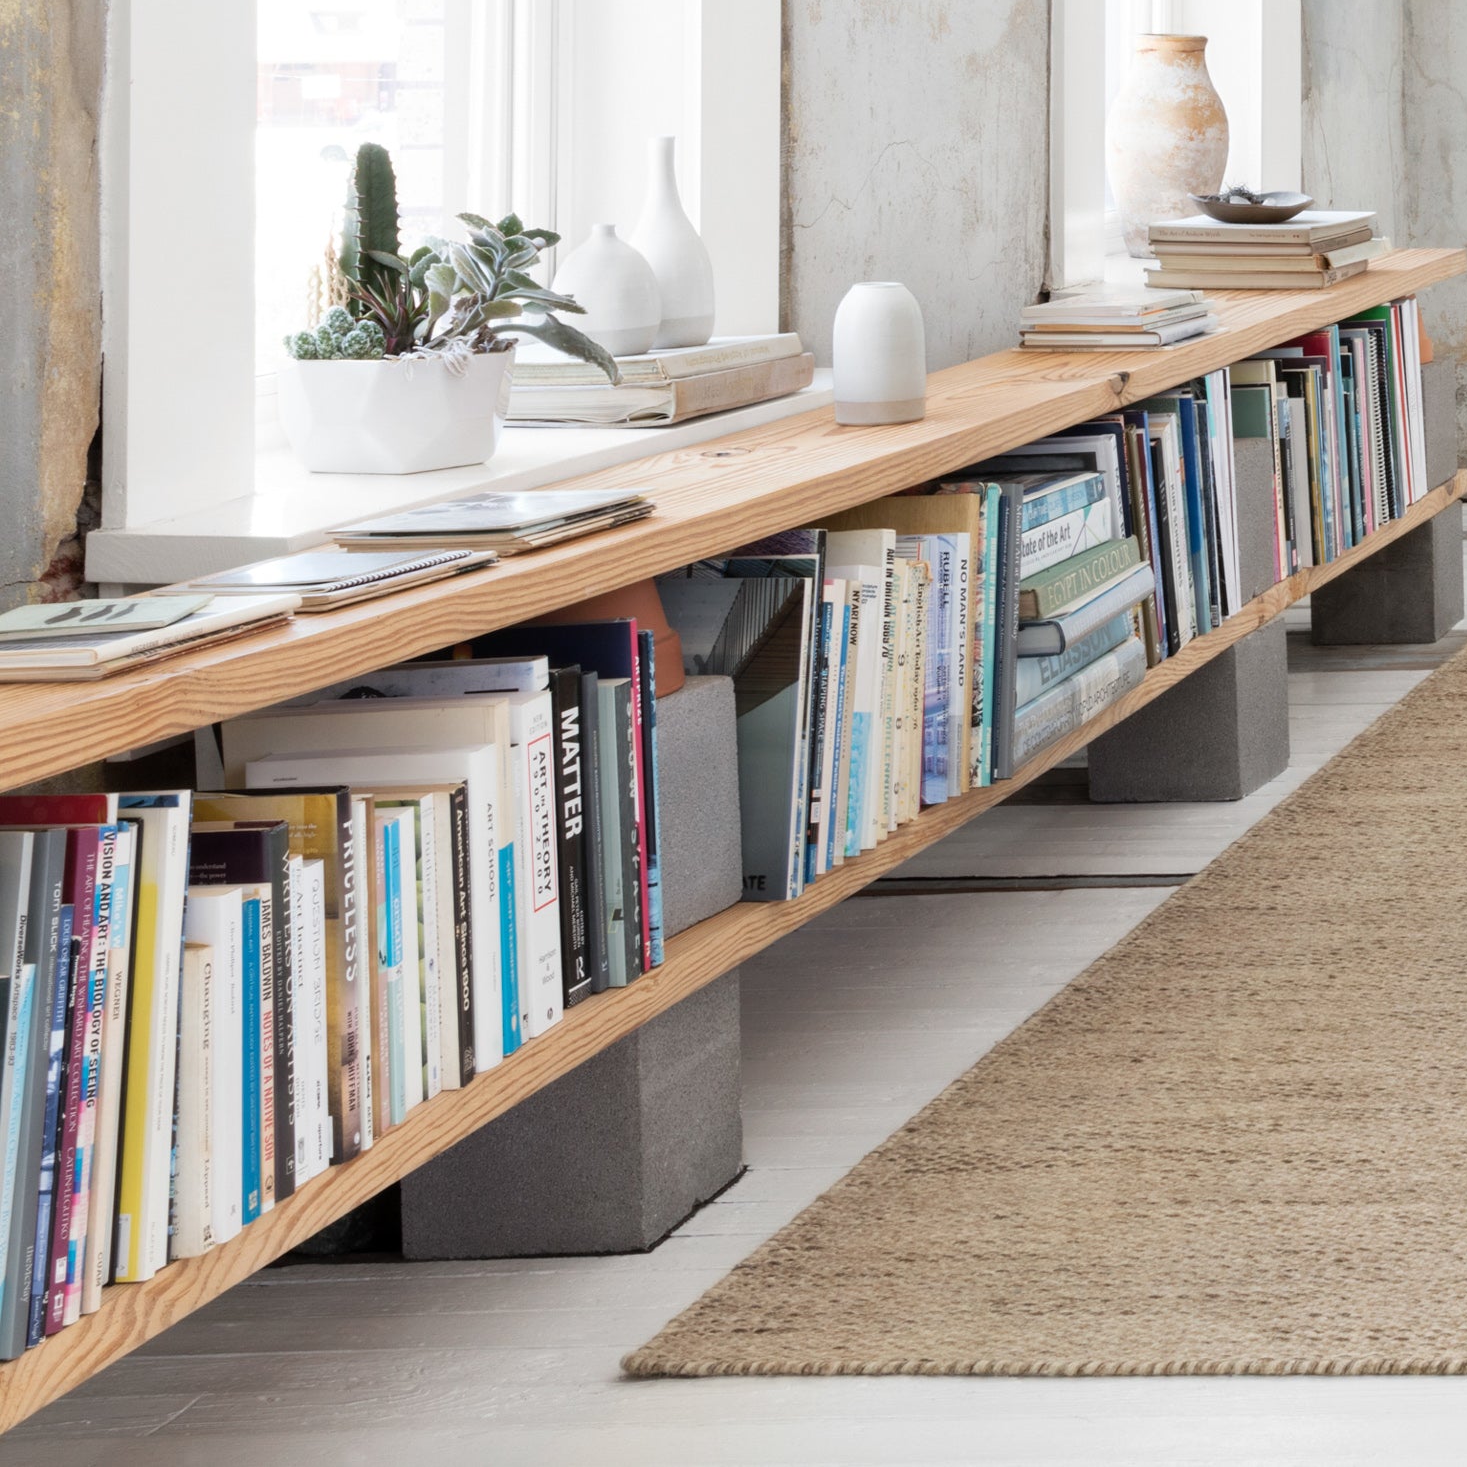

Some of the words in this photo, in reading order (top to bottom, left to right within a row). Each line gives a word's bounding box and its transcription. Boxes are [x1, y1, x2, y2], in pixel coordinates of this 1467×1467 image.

[886, 548, 895, 564] ART
[1021, 538, 1038, 558] tate
[1038, 534, 1046, 552] of
[1046, 529, 1059, 549] the
[1060, 523, 1072, 544] Art
[886, 568, 894, 578] IN
[942, 551, 950, 606] RUBELL
[960, 558, 968, 582] NO
[1047, 572, 1077, 609] EGYPT
[1078, 567, 1091, 591] IN
[1092, 544, 1131, 583] COLOUR
[851, 604, 859, 621] ART
[852, 590, 860, 603] NY
[884, 581, 894, 618] BRITAIN
[959, 587, 967, 639] MAN'S
[849, 622, 858, 646] NOW
[958, 644, 966, 687] LAND
[1037, 626, 1112, 685] ELIASSON
[538, 751, 548, 789] ART
[561, 705, 583, 840] MATTER
[540, 794, 546, 807] IN
[86, 852, 96, 872] THE
[102, 831, 114, 880] VISION
[455, 809, 465, 889] American
[541, 812, 552, 892] THEORY
[84, 874, 93, 893] ART
[487, 838, 496, 903] SCHOOL
[84, 897, 92, 911] OF
[99, 882, 110, 911] AND
[113, 887, 125, 932] Mike's
[343, 820, 359, 982] PRICELESS
[458, 891, 467, 917] Art
[62, 918, 71, 946] LOUIS
[98, 914, 109, 946] ART:
[261, 898, 271, 940] JAMES
[15, 914, 27, 980] DiverseWorks
[58, 947, 69, 978] OSCAR
[96, 951, 106, 976] THE
[461, 922, 470, 968] Since
[78, 964, 87, 983] THE
[261, 944, 272, 1002] BALDWIN
[461, 969, 470, 1012] 1900
[11, 982, 21, 1021] Artspace
[56, 979, 67, 1023] GRIFFITH
[74, 985, 86, 1036] WISHARD
[92, 979, 105, 1036] BIOLOGY
[112, 970, 123, 1021] WEGNER
[201, 963, 213, 1051] Changing
[7, 1031, 17, 1067] 1983-93
[73, 1039, 83, 1059] ART
[90, 1038, 100, 1055] OF
[263, 1010, 274, 1052] NOTES
[347, 1031, 355, 1056] JOHN
[86, 1058, 98, 1109] SEEING
[263, 1055, 274, 1070] OF
[264, 1075, 274, 1084] A
[69, 1062, 81, 1133] COLLECTION
[348, 1060, 357, 1112] SHIFFMAN
[264, 1089, 274, 1132] NATIVE
[264, 1135, 275, 1162] SON
[60, 1146, 75, 1240] CATLIN-LEGUTKO
[20, 1244, 35, 1303] theMcNay
